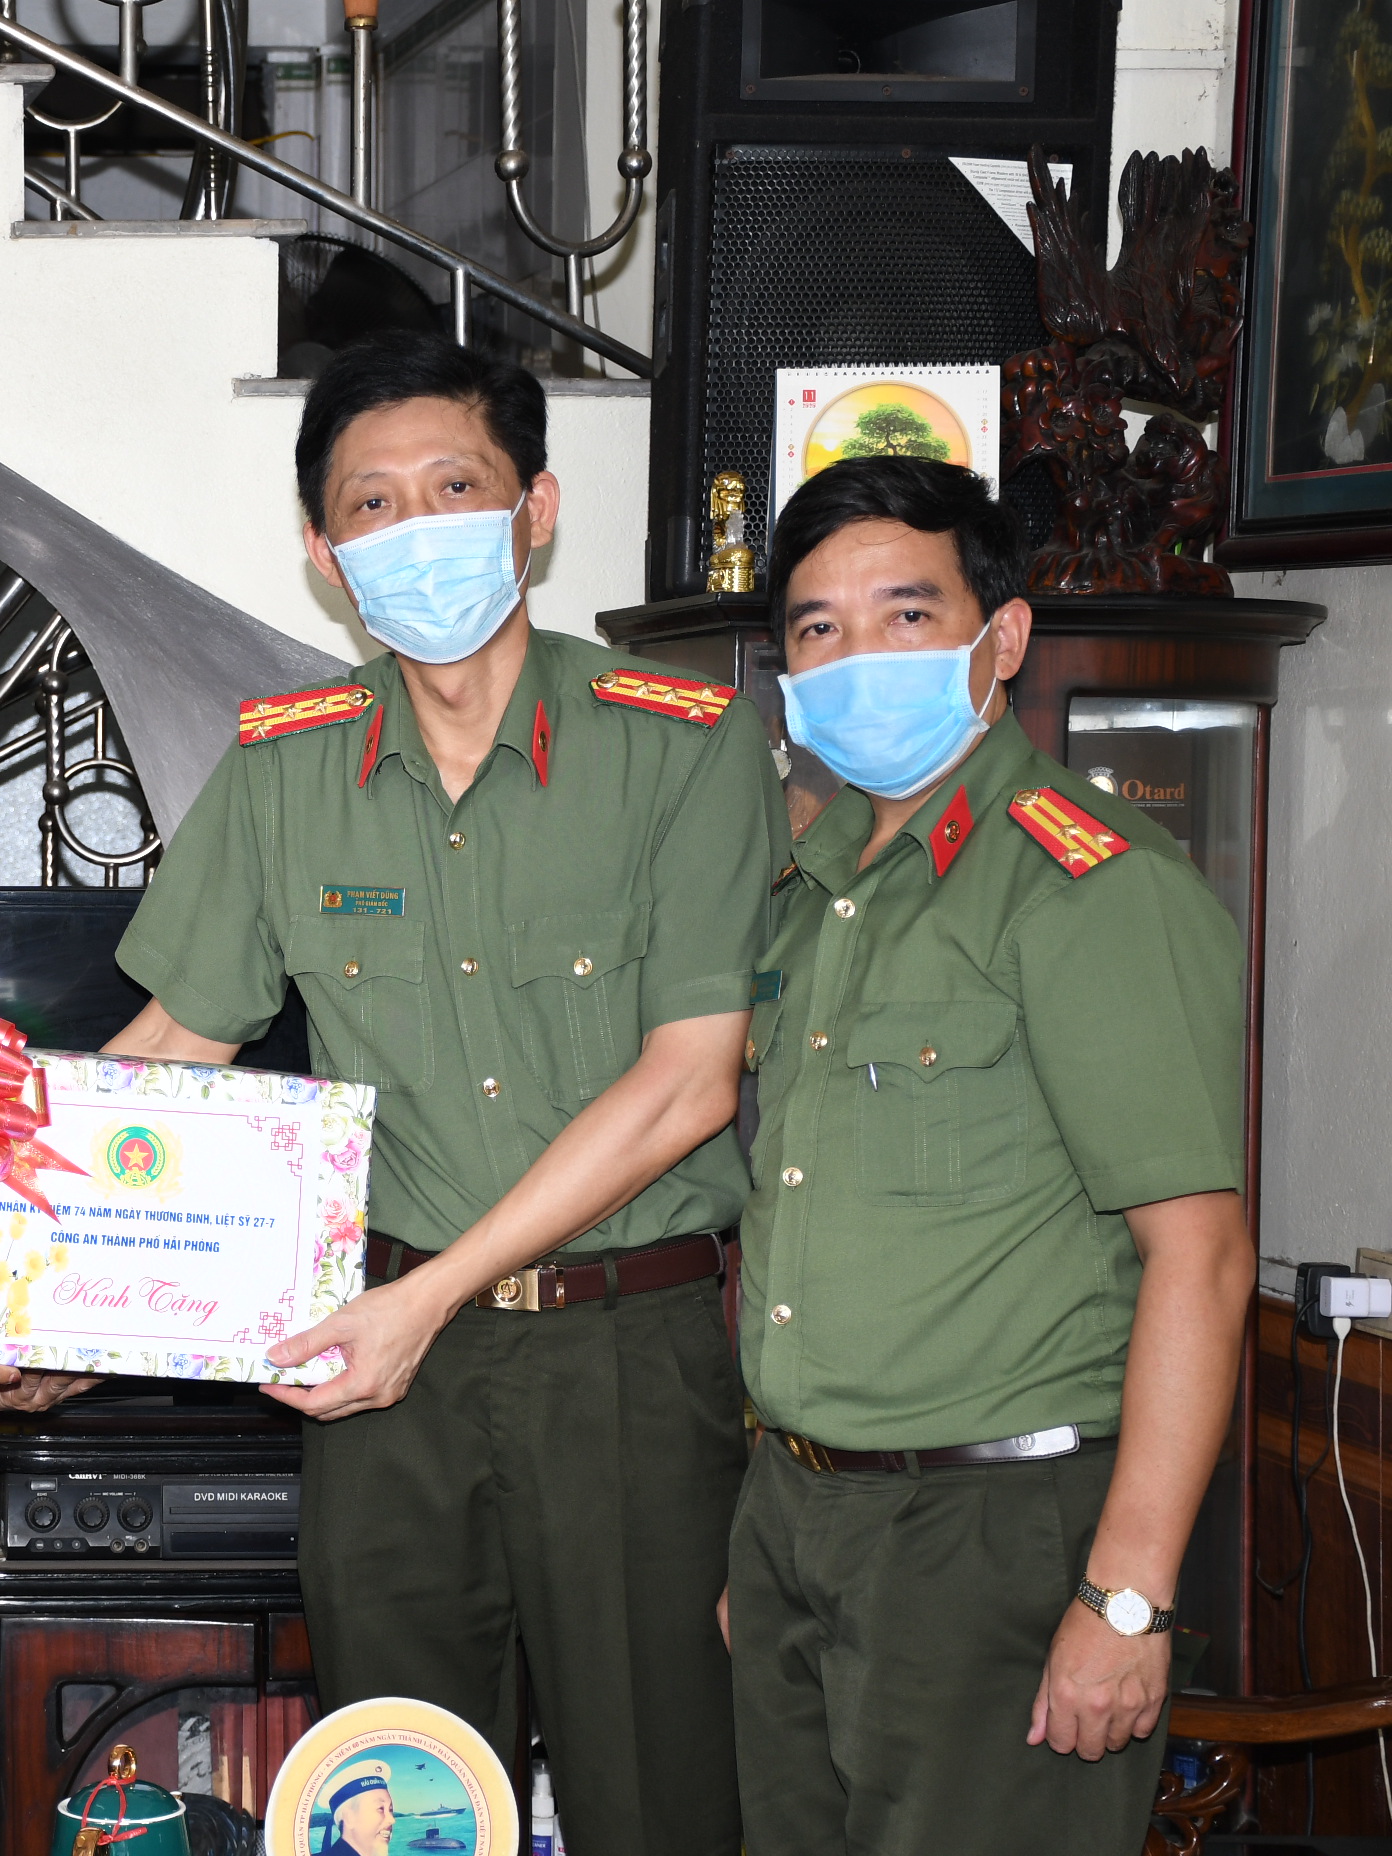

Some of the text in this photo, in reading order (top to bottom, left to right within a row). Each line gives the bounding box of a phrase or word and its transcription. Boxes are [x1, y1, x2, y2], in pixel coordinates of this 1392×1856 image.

[1122, 779, 1185, 800] Otard
[366, 888, 379, 899] VIẾT
[0, 1200, 27, 1213] NHÂN
[30, 1202, 41, 1214] K
[74, 1206, 86, 1217] 74
[89, 1206, 112, 1219] NĂM
[115, 1207, 142, 1220] NGÀY
[145, 1210, 183, 1223] THƯƠNG
[186, 1212, 212, 1226] BINH,
[216, 1213, 236, 1228] LIỆT
[238, 1214, 250, 1227] SỸ
[253, 1217, 275, 1229] 27-7
[50, 1230, 220, 1252] CÔNG AN THÀNH PHỐ HẢI PHÒNG
[53, 1273, 220, 1327] Kính Tặng
[194, 1492, 288, 1501] DVD MIDI KARAOKE
